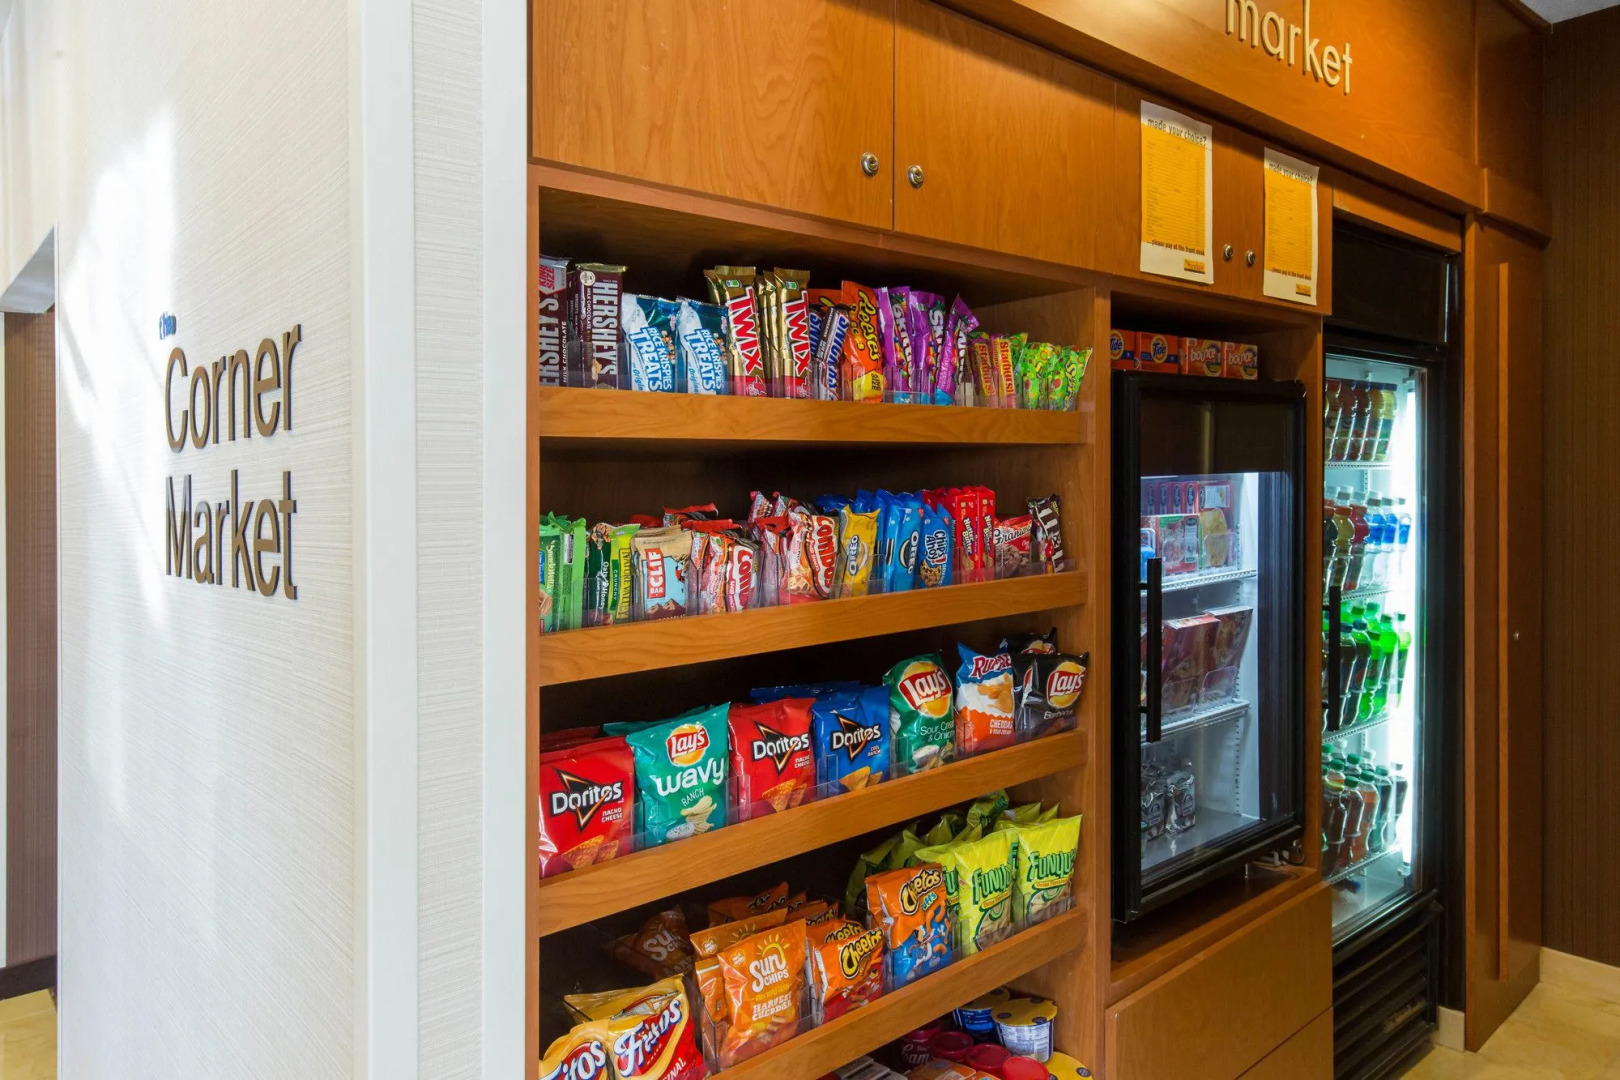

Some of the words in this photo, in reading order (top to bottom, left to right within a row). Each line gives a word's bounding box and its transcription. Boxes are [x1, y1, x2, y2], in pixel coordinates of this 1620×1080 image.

[1226, 0, 1352, 95] market
[592, 282, 619, 375] HERSHEY'S
[701, 328, 715, 350] RICE
[728, 288, 764, 376] TWIX
[785, 291, 811, 377] TWIX
[628, 328, 662, 392] TREATS
[646, 327, 663, 350] RICE
[658, 348, 673, 390] KRISPIES
[685, 330, 716, 391] TREATS
[165, 323, 302, 453] Corner
[165, 469, 298, 600] Market
[621, 549, 631, 585] NATURE
[648, 551, 664, 587] CLIF
[849, 534, 859, 576] OREO
[649, 586, 664, 594] BAR
[903, 667, 949, 708] Lay's
[1050, 671, 1085, 698] Lay's
[671, 728, 705, 759] Lay's
[753, 733, 810, 761] Doritos
[832, 724, 881, 750] Doritos
[920, 725, 939, 736] Sour
[654, 757, 725, 797] wavy
[680, 787, 705, 807] RANCH
[552, 782, 623, 816] Doritos
[601, 813, 623, 823] CHEESE
[602, 807, 622, 816] NACHO
[749, 953, 787, 993] Sun
[840, 929, 883, 979] Cheetos
[764, 969, 790, 986] CHIPS
[614, 999, 682, 1078] Fritos
